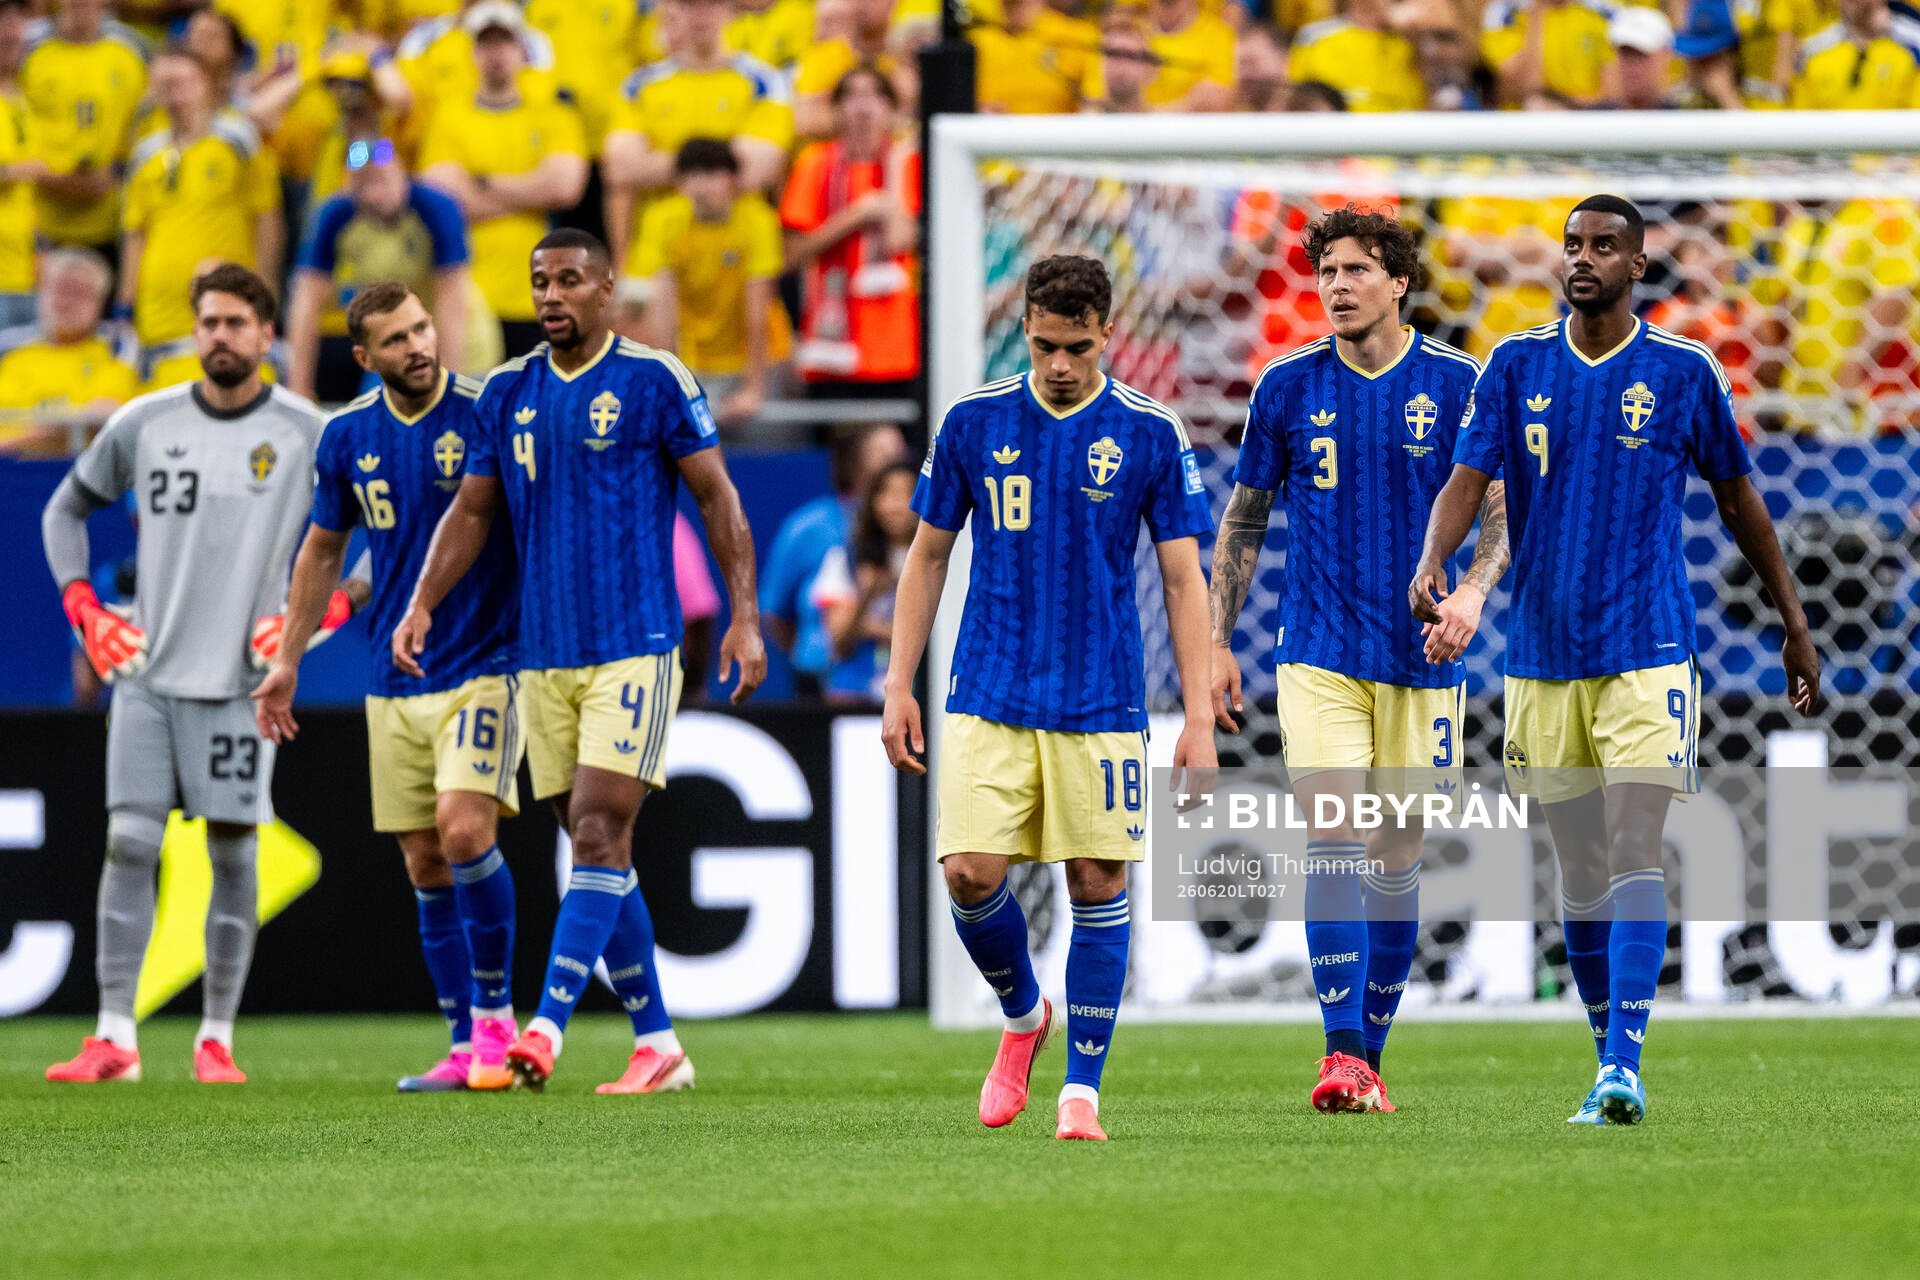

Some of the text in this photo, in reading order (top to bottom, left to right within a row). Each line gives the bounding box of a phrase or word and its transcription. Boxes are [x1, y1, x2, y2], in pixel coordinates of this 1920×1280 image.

[513, 431, 537, 482] 4
[1311, 437, 1338, 489] 3
[1525, 423, 1549, 477] 9
[149, 470, 199, 514] 23
[353, 479, 396, 529] 16
[984, 475, 1032, 531] 18
[457, 707, 498, 749] 16
[620, 682, 645, 729] 4
[1668, 688, 1686, 740] 9
[209, 734, 259, 781] 23
[1433, 717, 1452, 768] 3
[1100, 759, 1141, 811] 18
[1312, 952, 1359, 968] SVERIGE
[1070, 1004, 1116, 1020] SVERIGE
